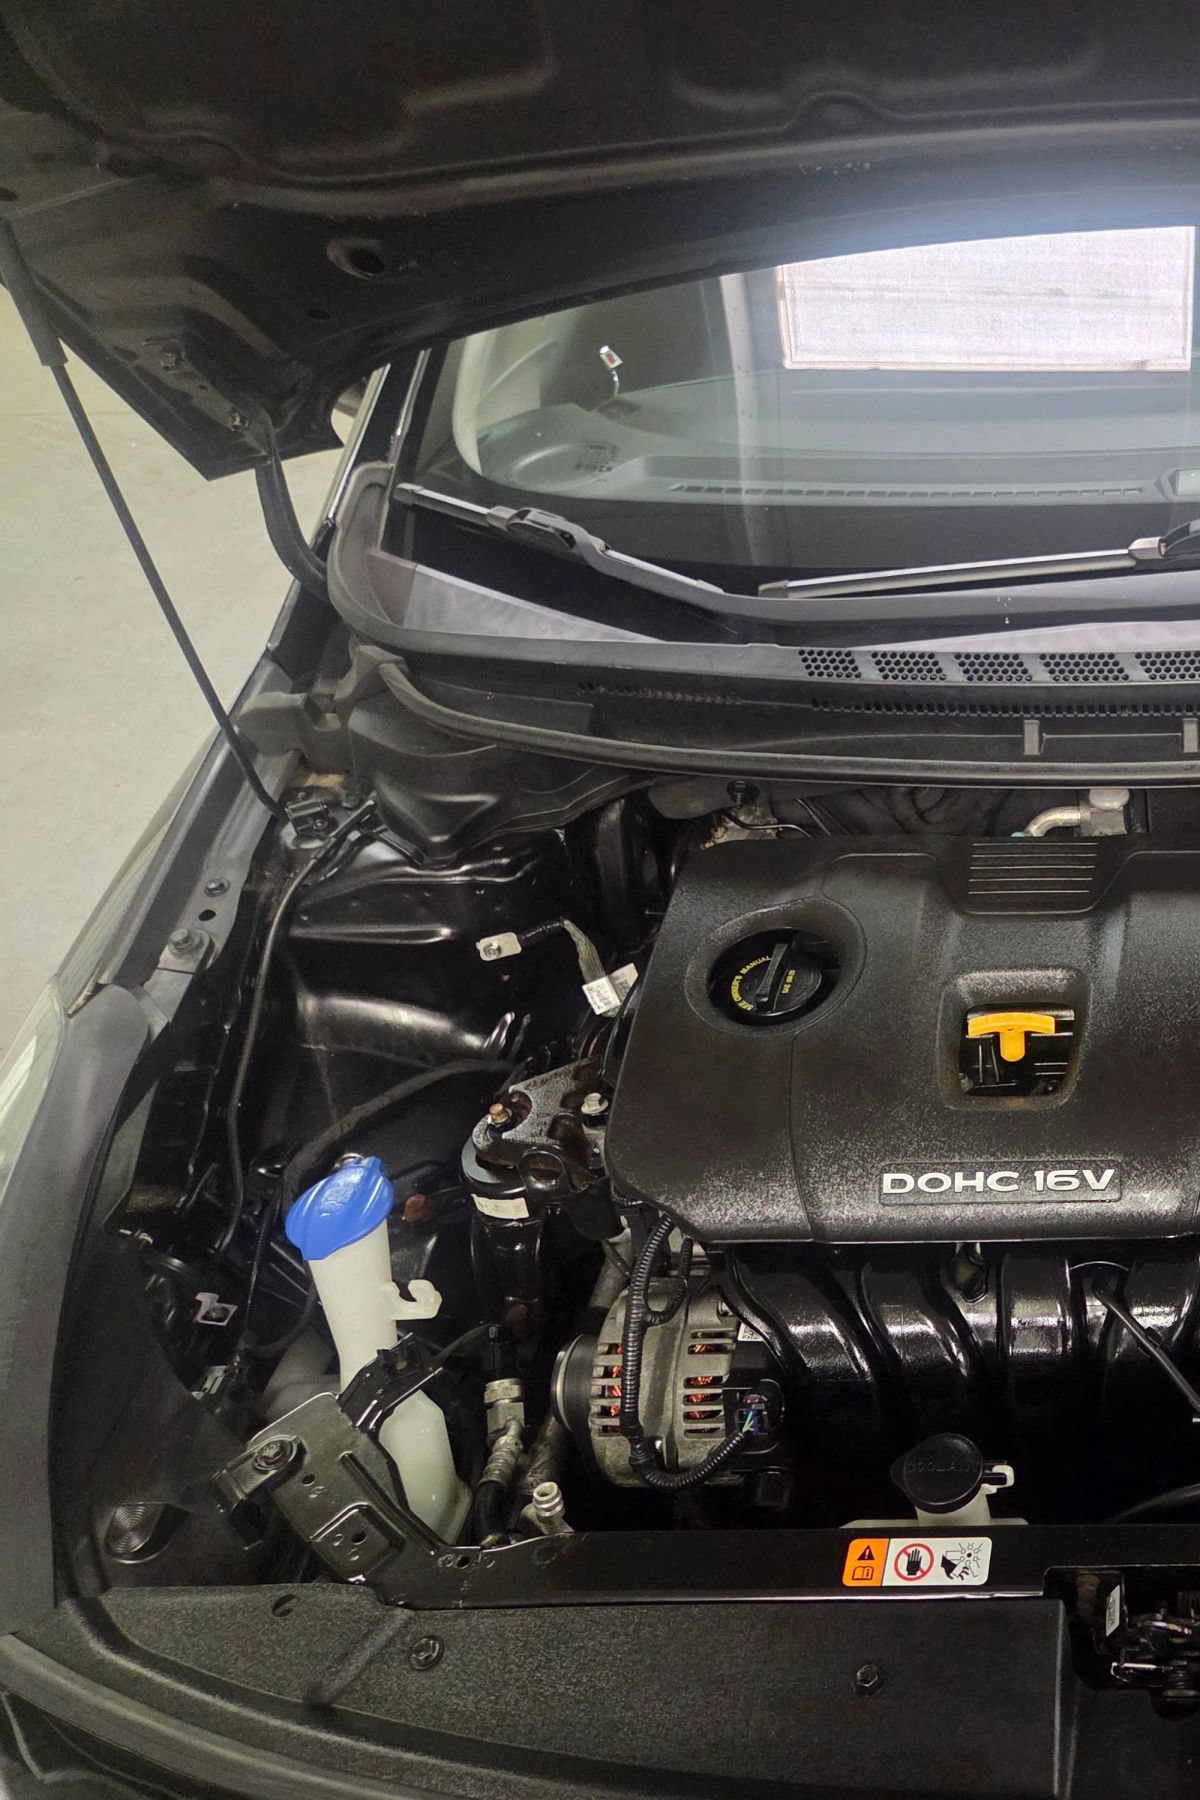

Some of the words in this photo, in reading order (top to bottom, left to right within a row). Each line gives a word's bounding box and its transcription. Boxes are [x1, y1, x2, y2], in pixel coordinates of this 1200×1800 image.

[740, 955, 773, 975] MANUAL
[882, 1172, 1020, 1194] DOHC
[1034, 1169, 1115, 1191] 16V
